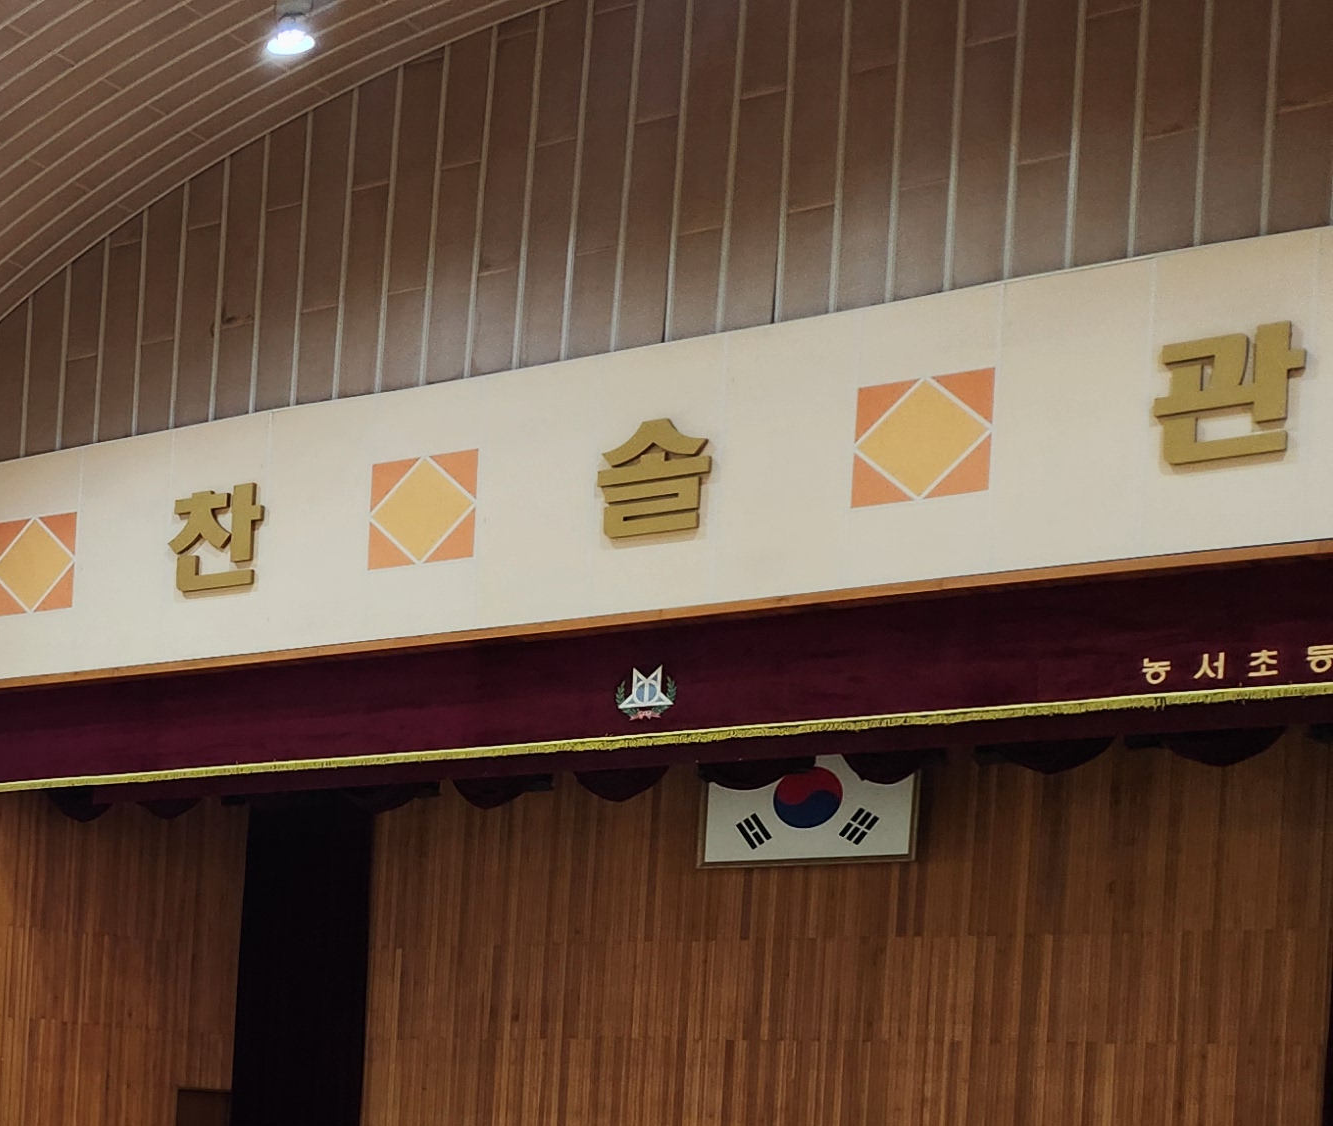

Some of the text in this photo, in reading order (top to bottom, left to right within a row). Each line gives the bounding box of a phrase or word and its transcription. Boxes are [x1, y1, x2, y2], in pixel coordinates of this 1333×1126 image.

[168, 320, 1307, 592] 찬 솔 관
